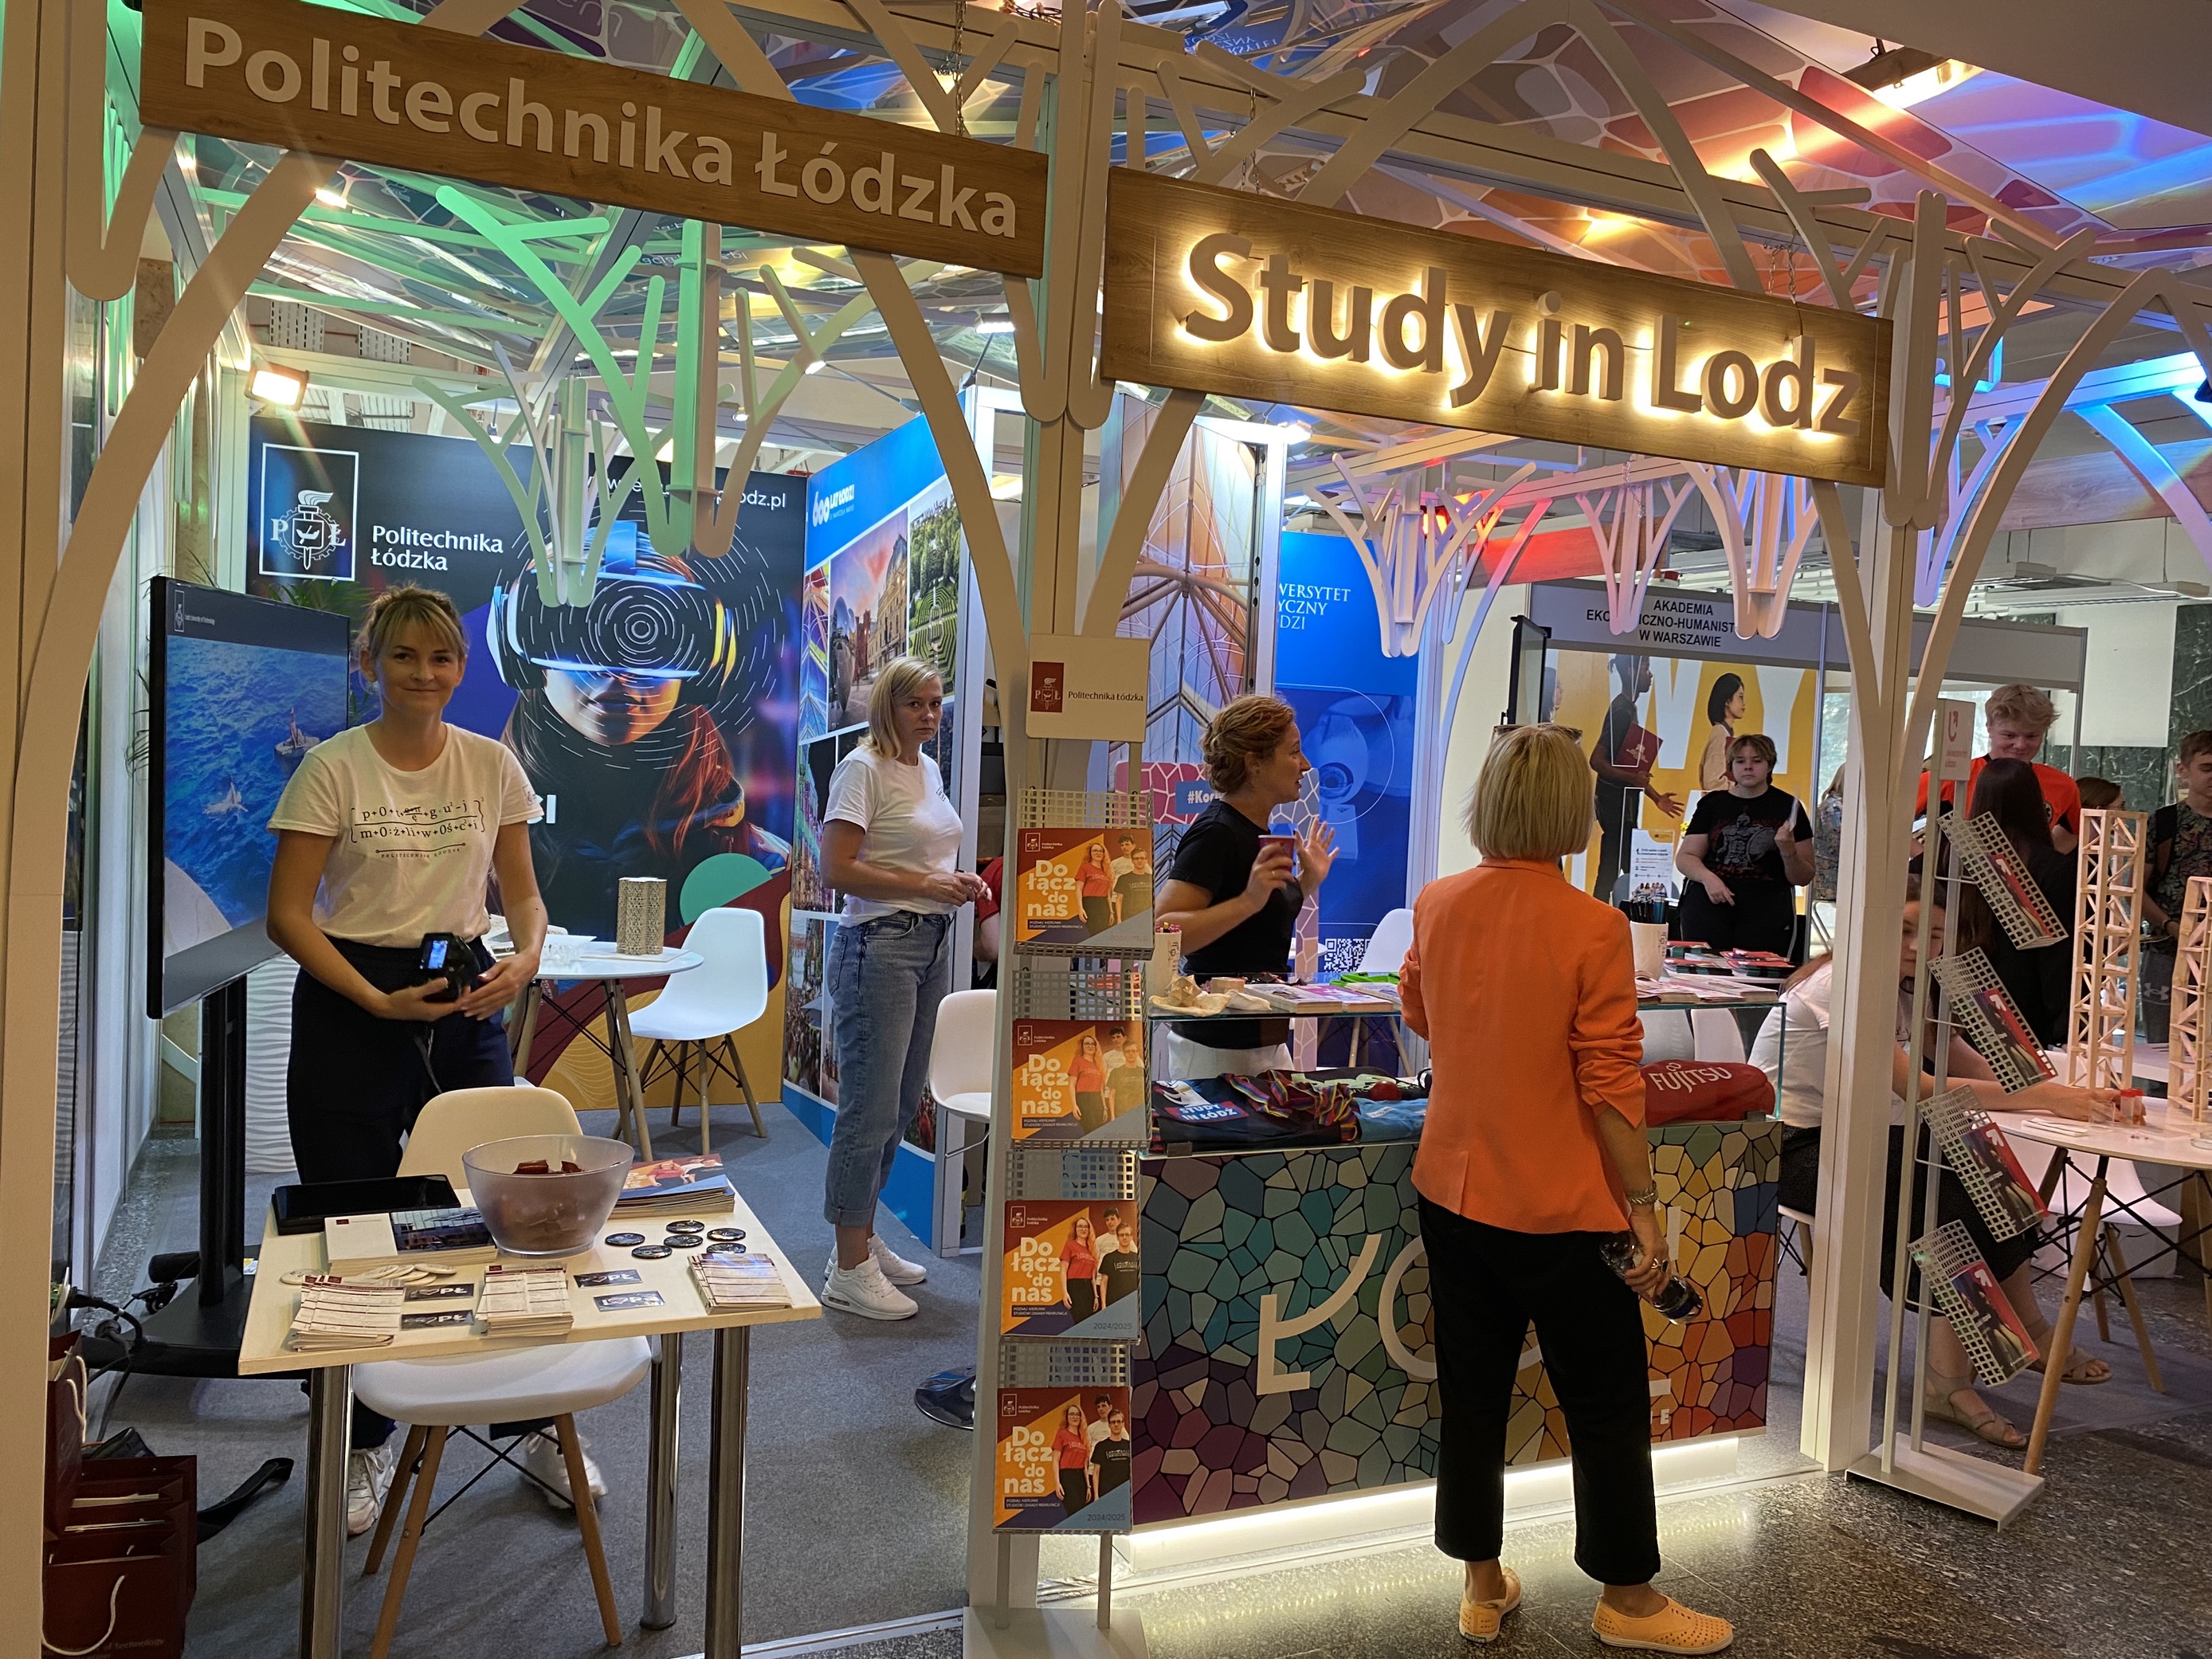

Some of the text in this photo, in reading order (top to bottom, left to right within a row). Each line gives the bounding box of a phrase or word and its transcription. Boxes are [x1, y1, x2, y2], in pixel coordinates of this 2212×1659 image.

[185, 17, 1017, 240] Politechnika Łódzka
[1185, 233, 1861, 437] Study in Lodz
[372, 525, 504, 554] Politechnika
[371, 547, 449, 571] Łódzka
[1278, 599, 1328, 616] YCZNY
[1653, 599, 1713, 616] AKADEMIA
[1280, 614, 1305, 629] DZI
[1639, 629, 1721, 648] W WARSZAWIE
[1068, 691, 1115, 700] Politechnika
[1036, 860, 1069, 877] Do
[1026, 873, 1076, 896] łącz
[1048, 891, 1069, 904] do
[1027, 903, 1069, 917] nas
[1028, 1054, 1061, 1072] Do
[1020, 1068, 1069, 1092] łącz
[1648, 1066, 1732, 1093] FUJITSU
[1041, 1086, 1062, 1100] do
[1022, 1100, 1062, 1115] nas
[1179, 1104, 1221, 1114] STUDY
[1201, 1108, 1237, 1120] ŁÓDŹ
[1020, 1237, 1053, 1257] Do
[1011, 1253, 1061, 1278] łącz
[1032, 1273, 1053, 1287] do
[1011, 1287, 1053, 1302] nas
[1012, 1426, 1045, 1446] Do
[1002, 1442, 1053, 1469] łącz
[1024, 1463, 1045, 1477] do
[1004, 1477, 1045, 1494] nas
